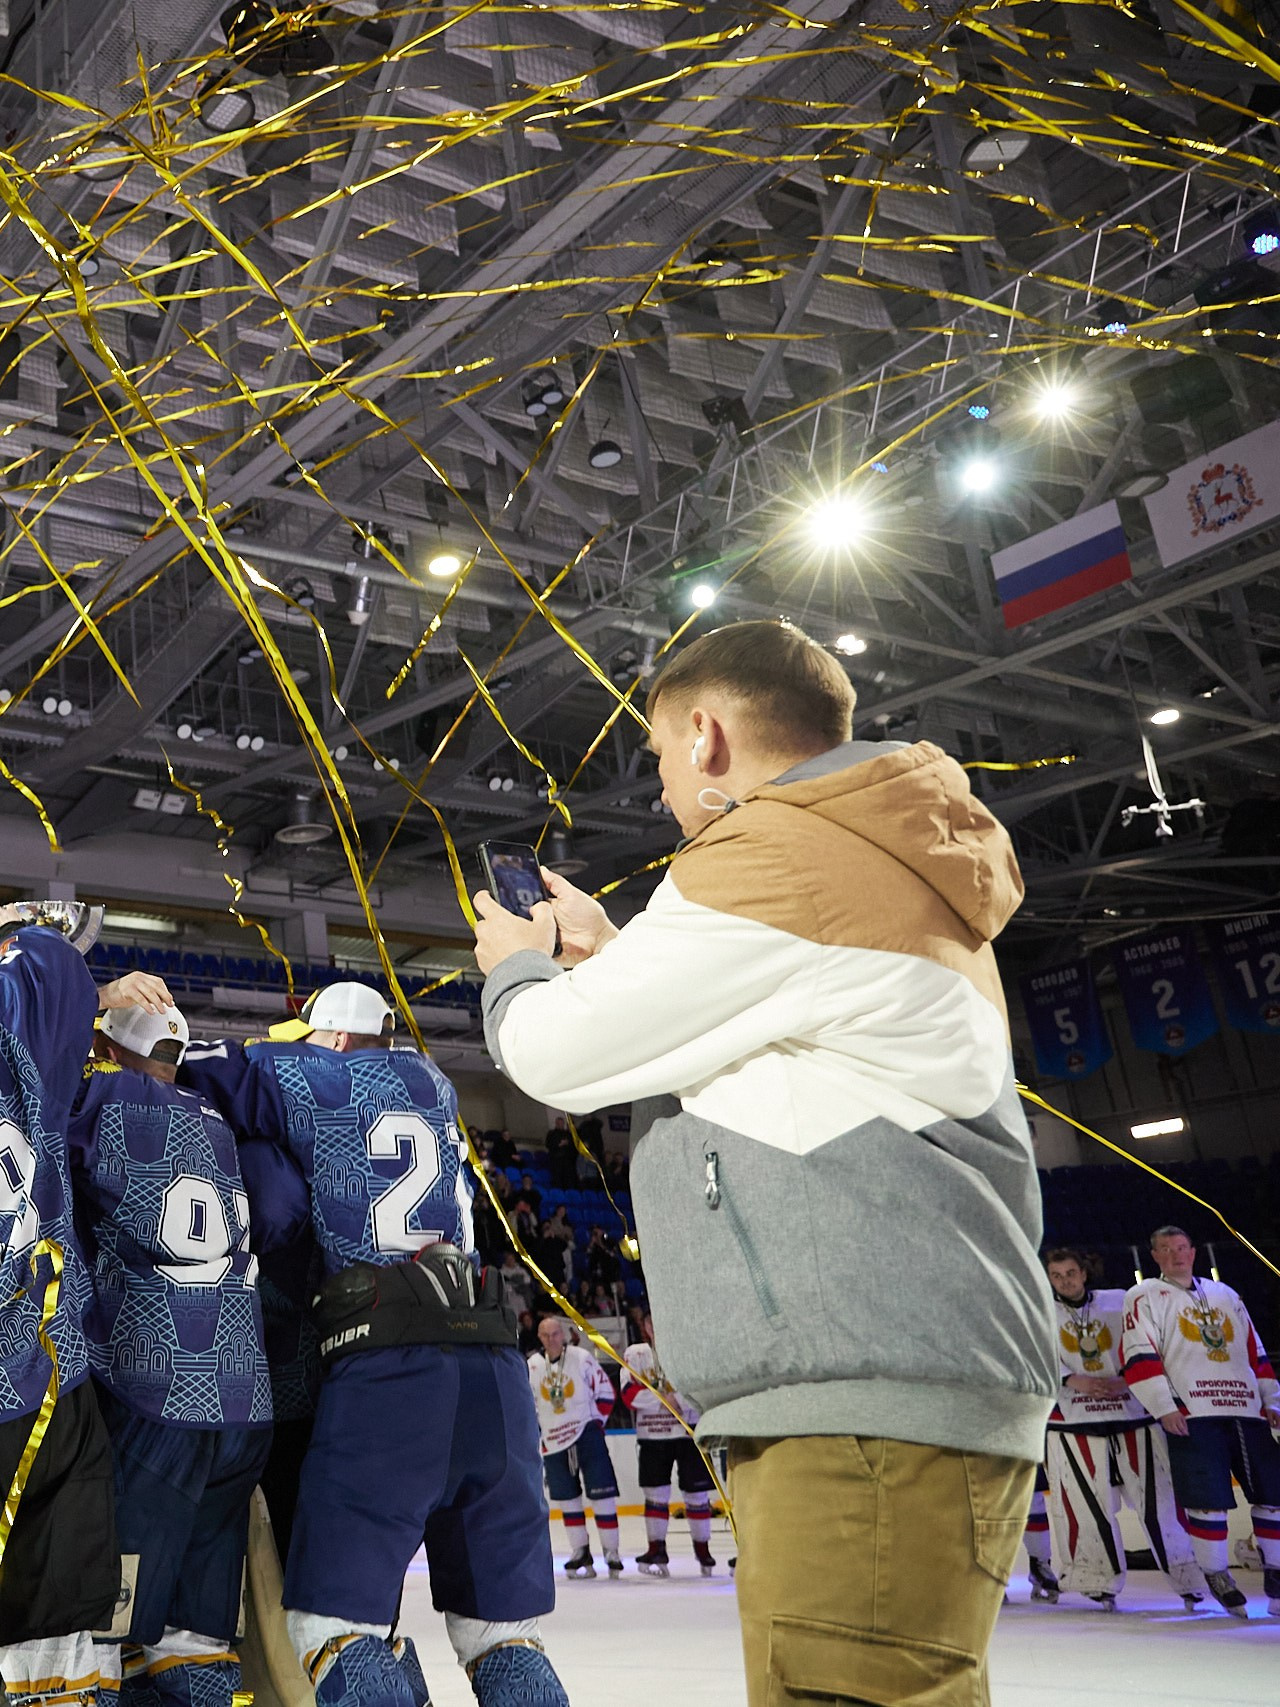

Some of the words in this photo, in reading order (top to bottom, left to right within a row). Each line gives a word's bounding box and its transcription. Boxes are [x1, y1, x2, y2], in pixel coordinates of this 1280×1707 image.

[1235, 952, 1280, 998] 12
[1151, 979, 1181, 1019] 2
[1054, 1007, 1079, 1045] 5
